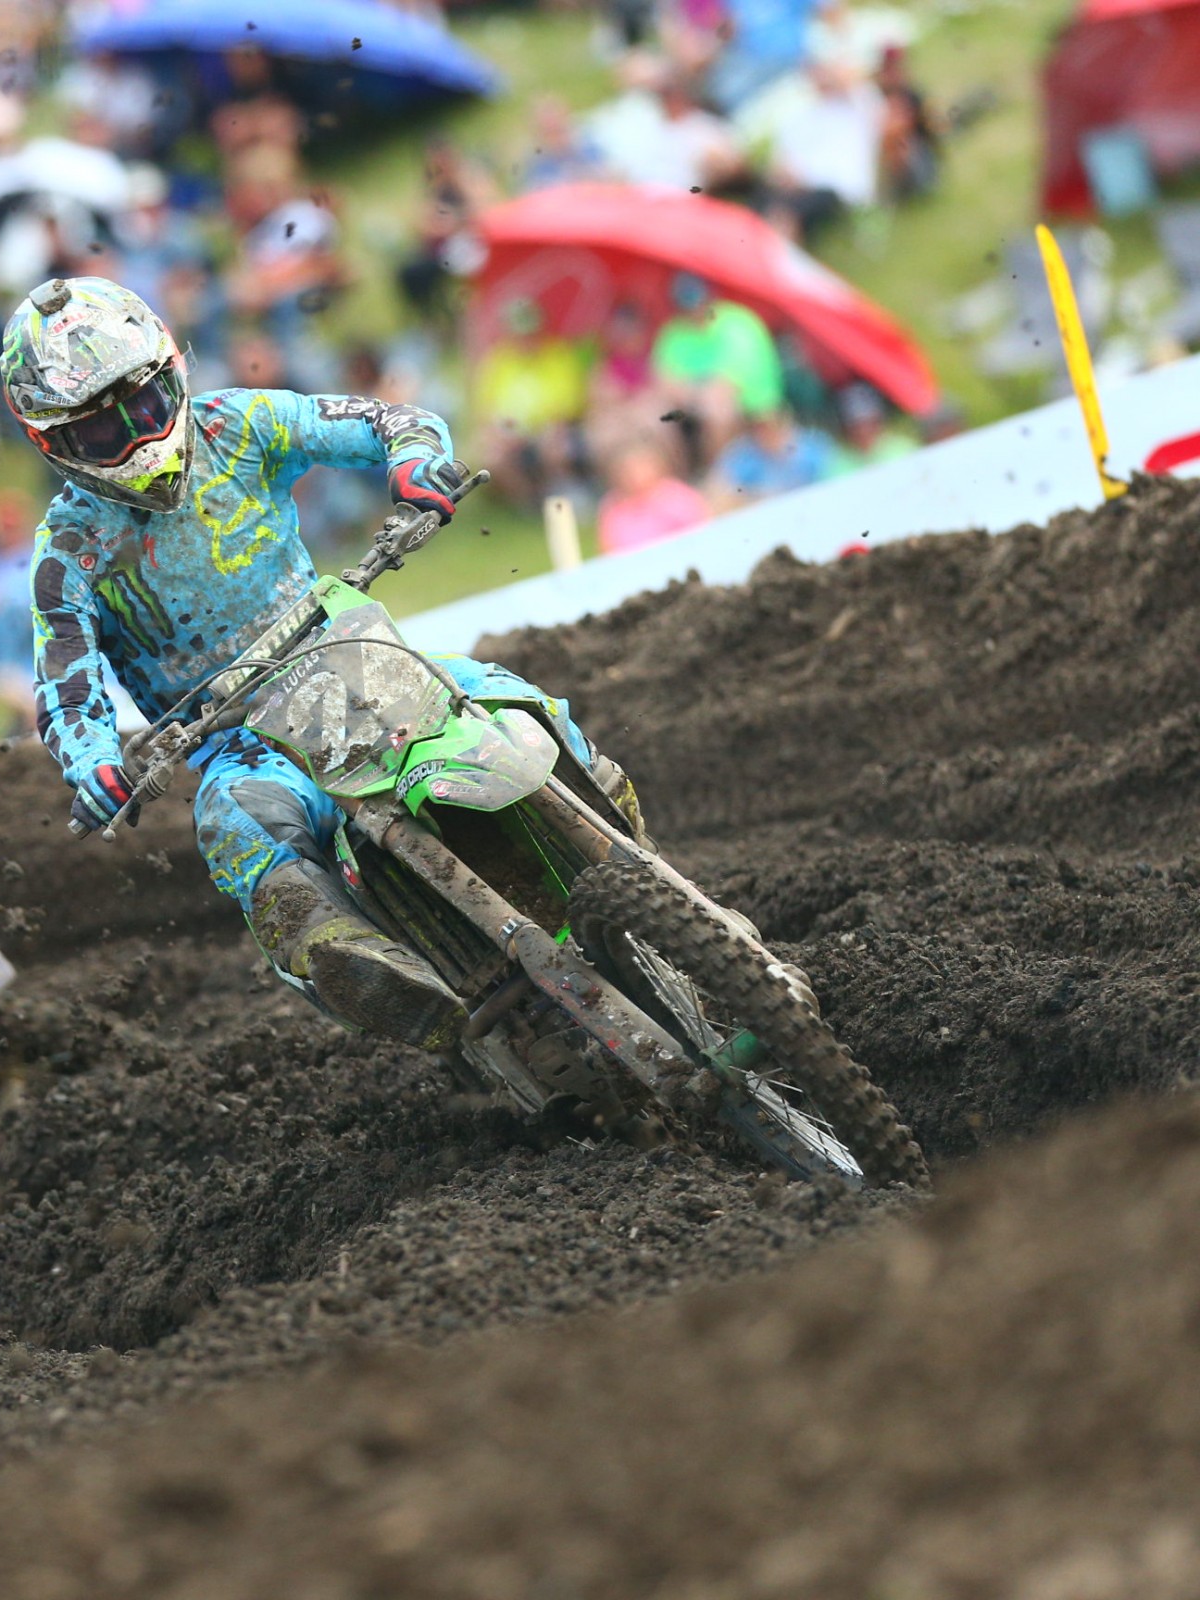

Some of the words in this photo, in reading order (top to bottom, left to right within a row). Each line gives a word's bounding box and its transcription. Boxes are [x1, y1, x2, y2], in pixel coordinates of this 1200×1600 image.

[406, 518, 436, 549] ARC
[281, 652, 320, 695] LUCAS
[408, 759, 446, 788] CIRCUIT
